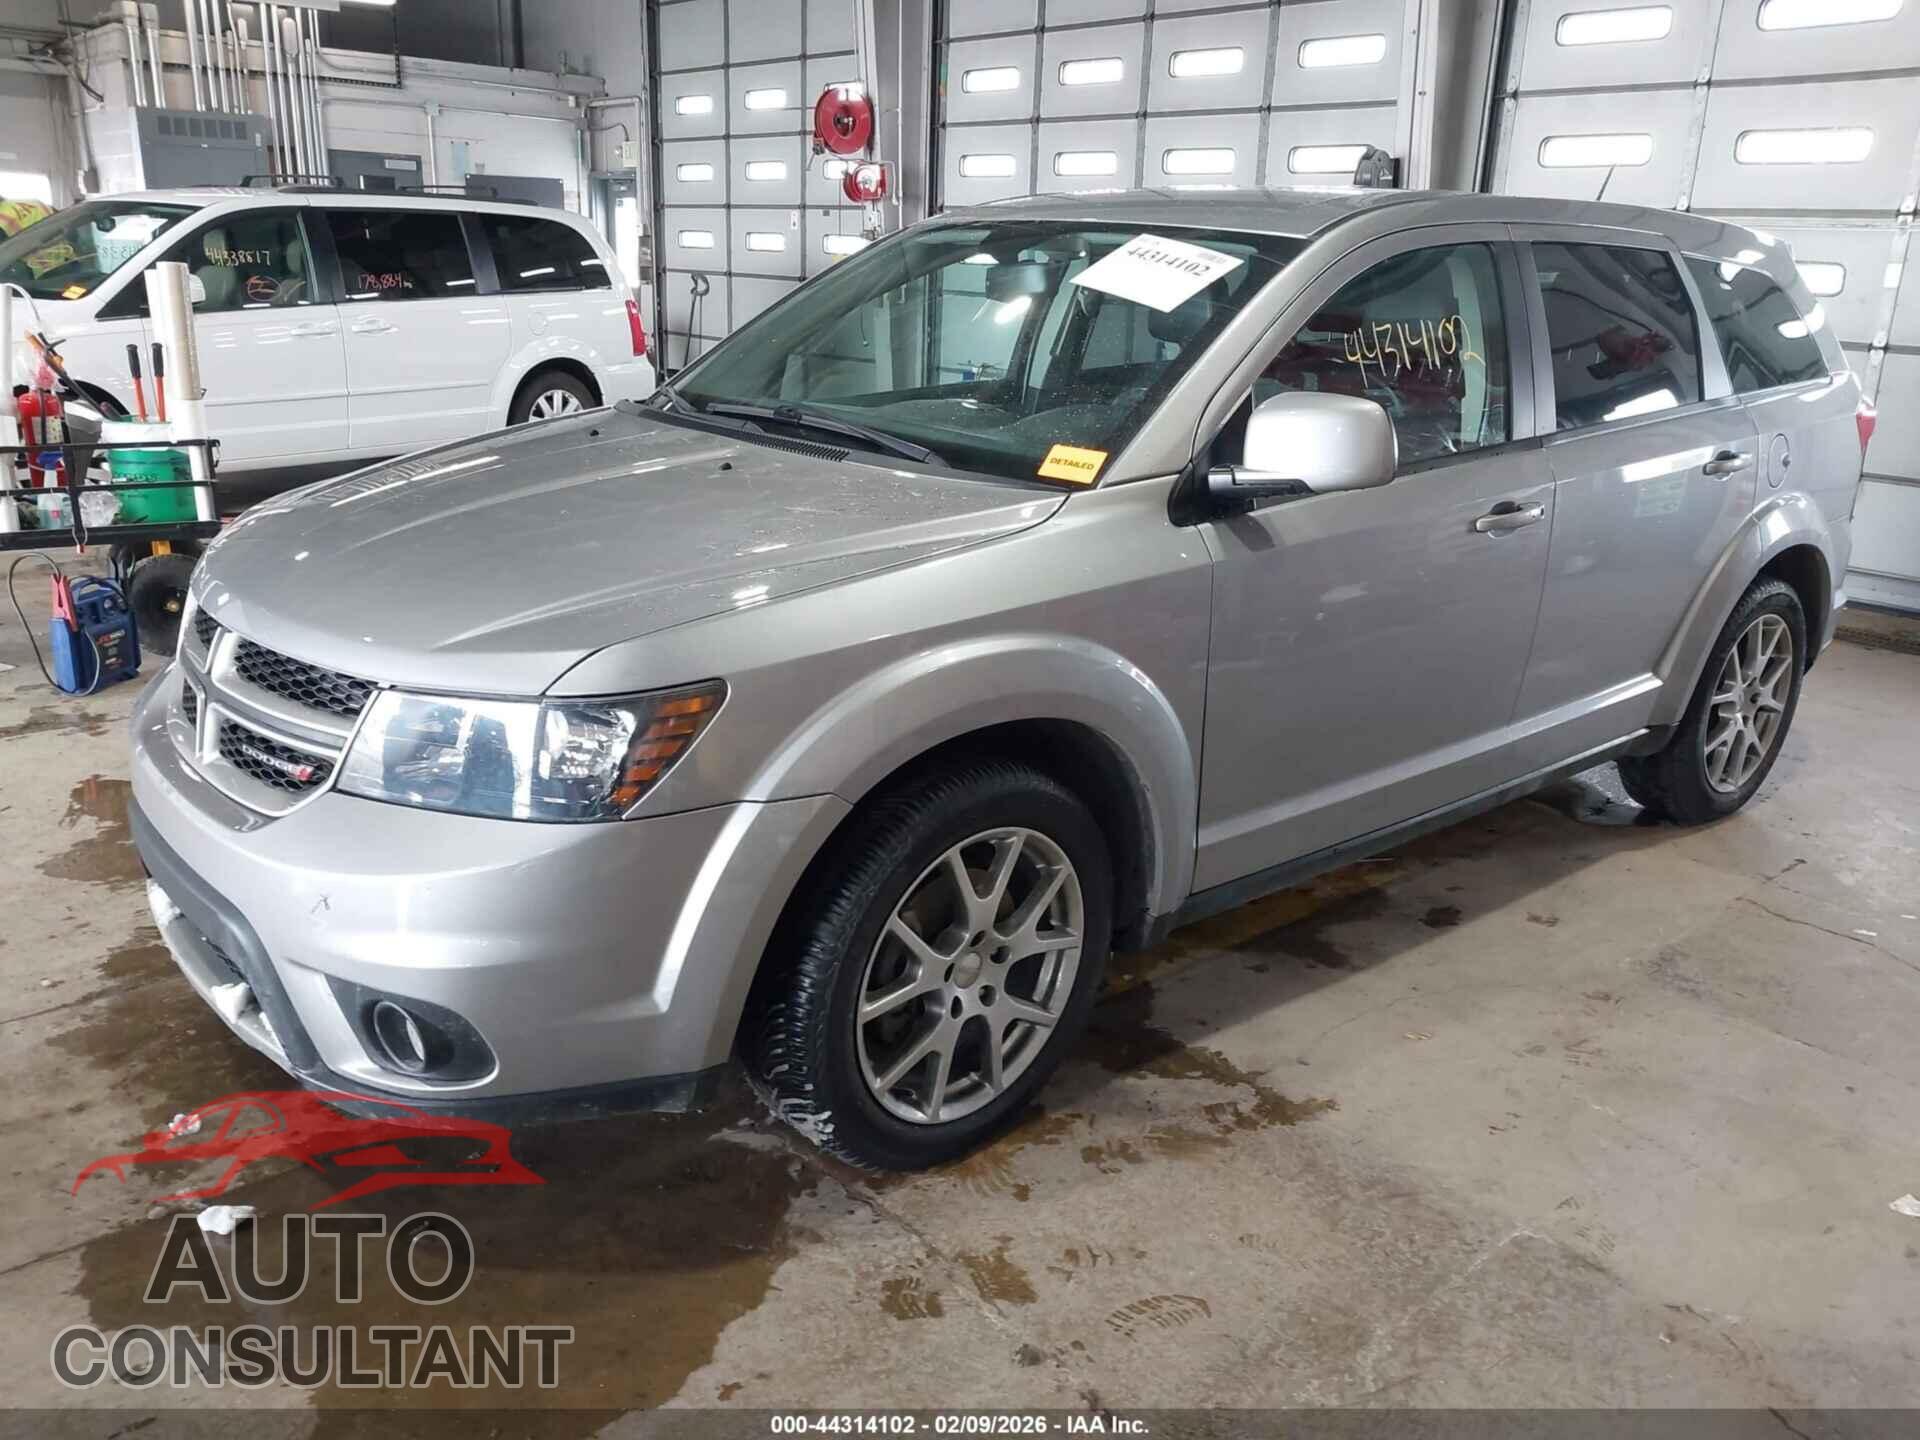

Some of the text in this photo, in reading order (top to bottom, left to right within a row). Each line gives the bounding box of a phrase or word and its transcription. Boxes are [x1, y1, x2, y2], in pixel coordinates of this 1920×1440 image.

[1127, 247, 1210, 277] 44314102
[1344, 315, 1486, 389] 44314102
[1049, 457, 1095, 471] DETAILED
[242, 744, 299, 773] DODGE
